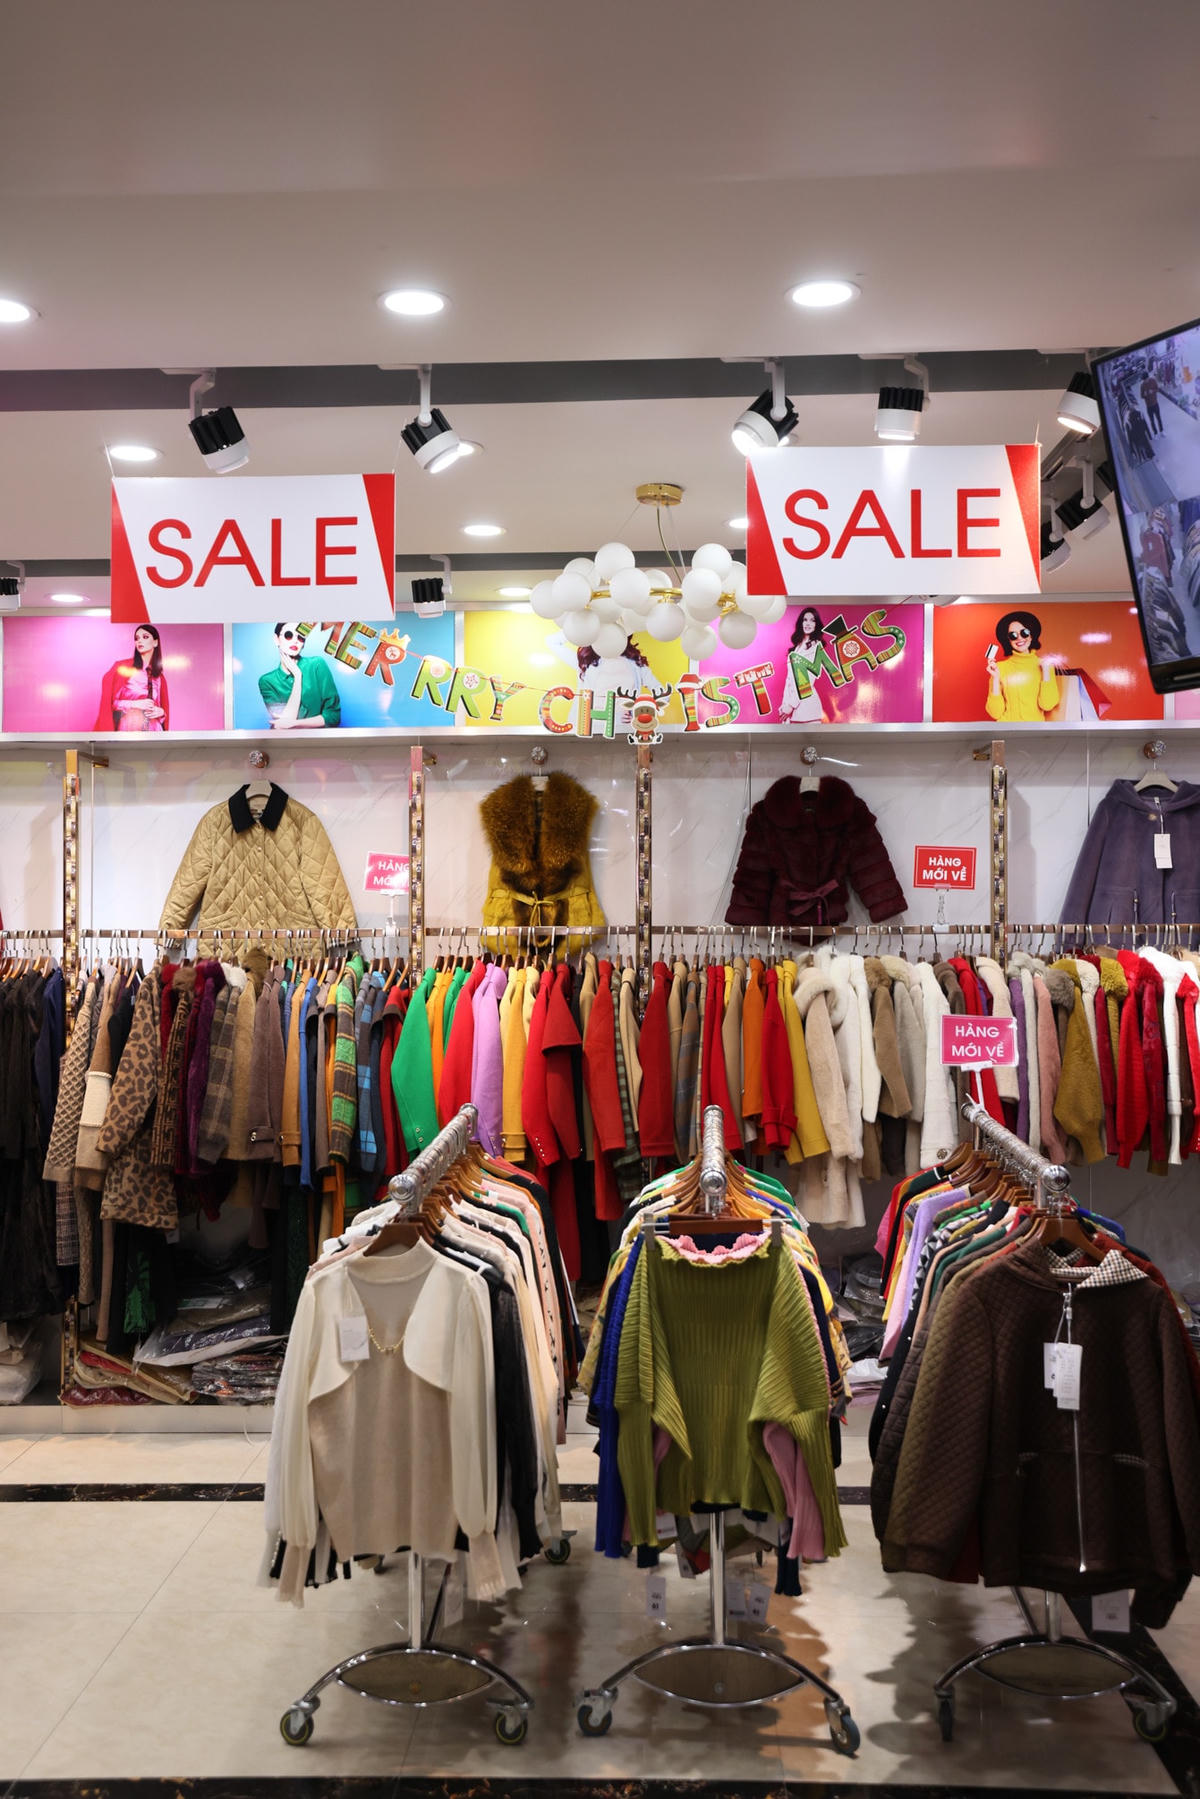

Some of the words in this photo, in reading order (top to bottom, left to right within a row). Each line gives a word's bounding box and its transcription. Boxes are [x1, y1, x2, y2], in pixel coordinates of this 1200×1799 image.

[782, 488, 1001, 560] SALE
[145, 516, 358, 589] SALE
[928, 854, 961, 867] HÀNG
[922, 867, 947, 880] MỚI
[951, 866, 967, 881] VỀ
[955, 1022, 1000, 1038] HÀNG
[951, 1042, 982, 1057] MỚI
[985, 1041, 1004, 1057] VỀ
